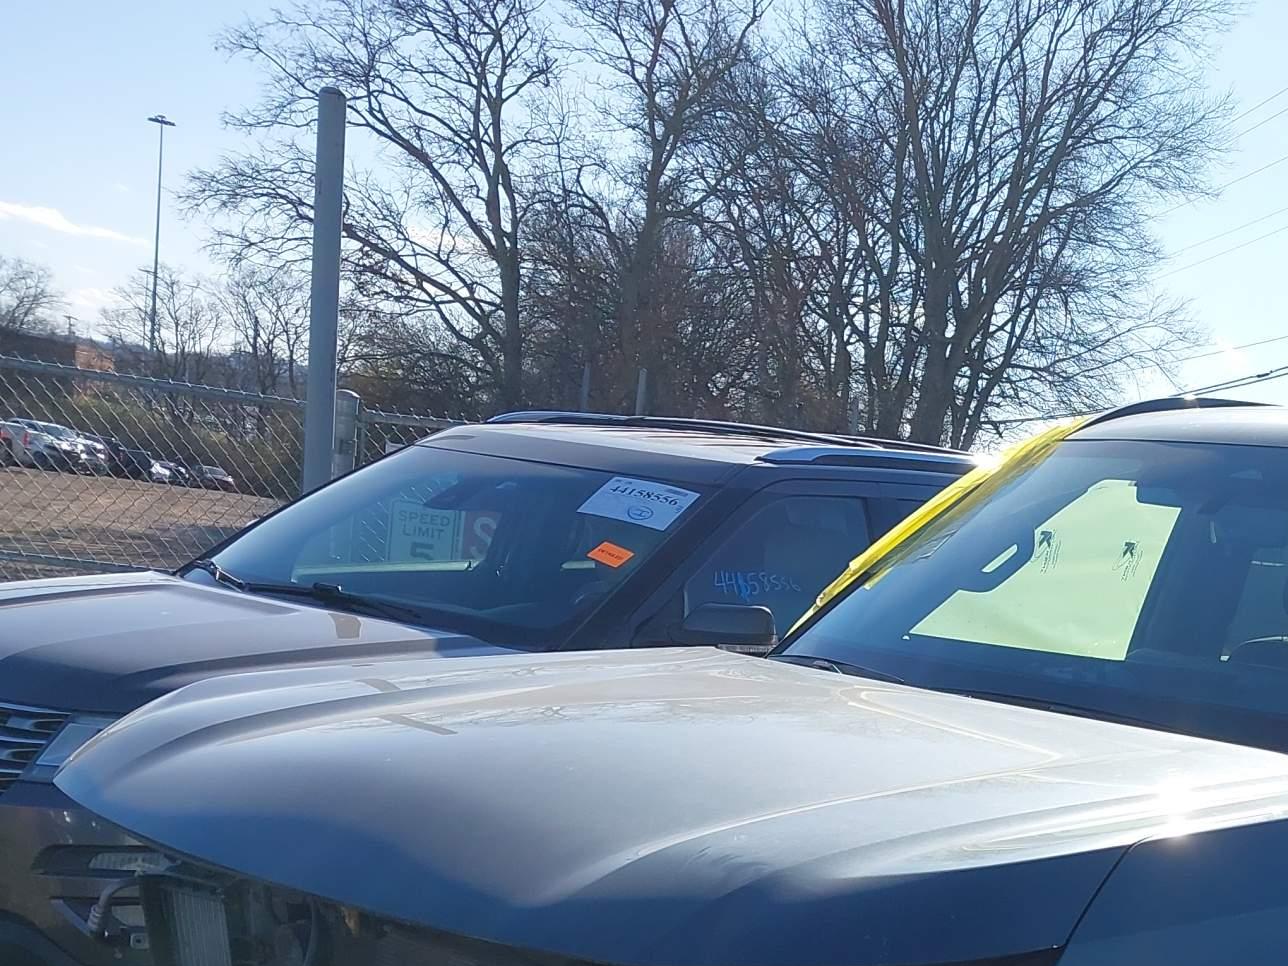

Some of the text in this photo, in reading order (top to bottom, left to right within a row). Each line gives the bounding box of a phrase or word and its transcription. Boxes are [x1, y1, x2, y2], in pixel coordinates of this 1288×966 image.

[610, 485, 678, 506] 44158556
[398, 510, 450, 527] SPEED
[402, 524, 444, 539] LIMIT
